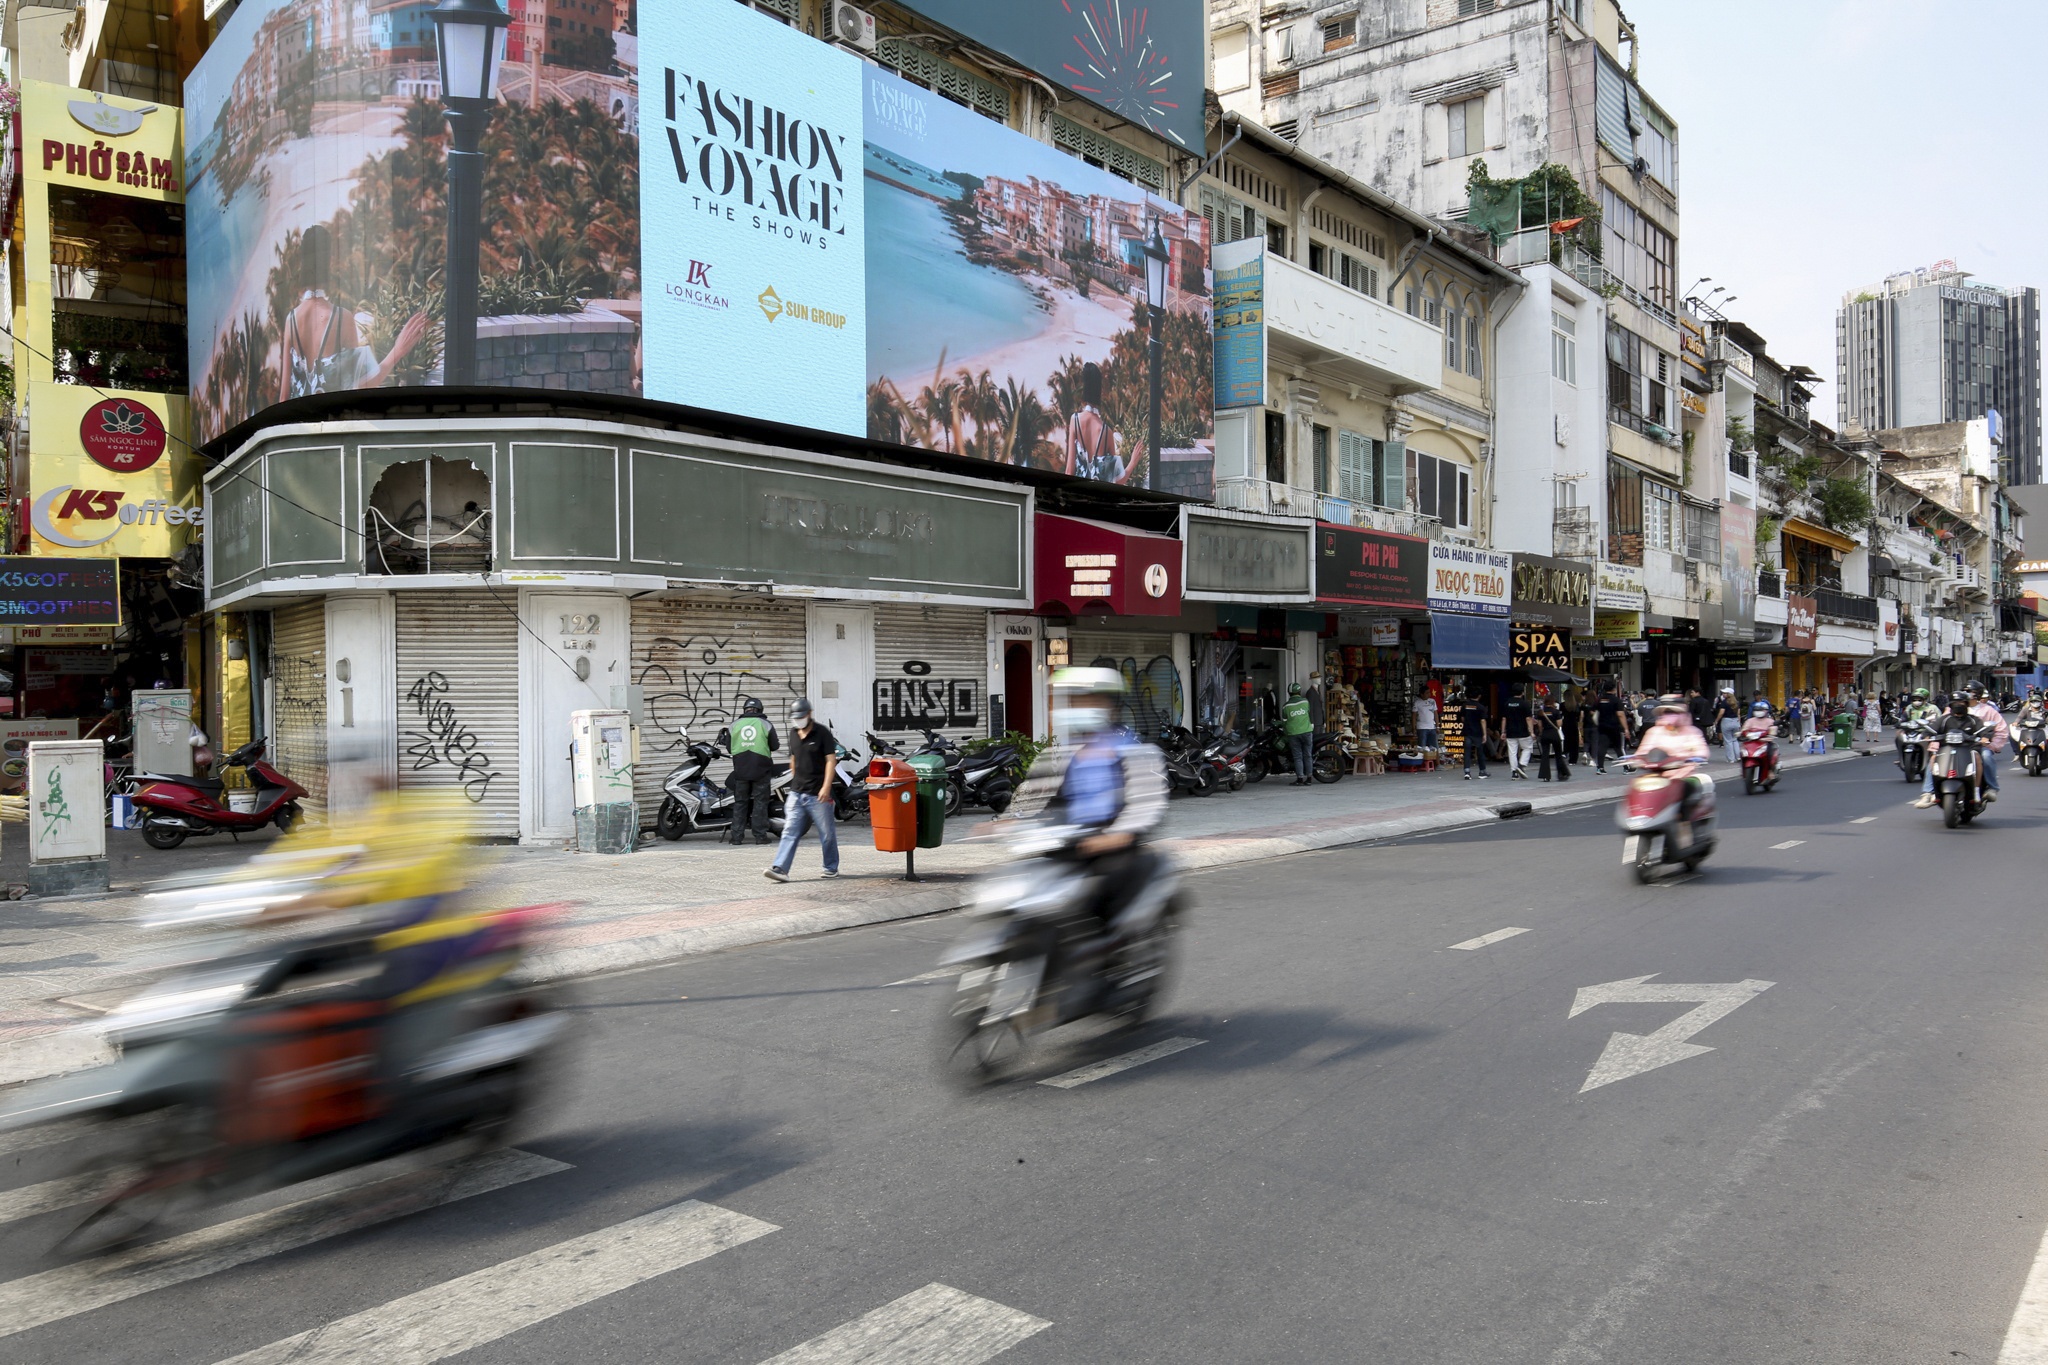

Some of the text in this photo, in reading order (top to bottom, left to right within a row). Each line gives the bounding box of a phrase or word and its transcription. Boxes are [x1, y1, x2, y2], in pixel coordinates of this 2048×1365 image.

[664, 66, 846, 182] FASHION
[42, 139, 113, 181] PHỞ
[116, 151, 173, 178] SÂM
[665, 125, 846, 236] VOYAGE
[692, 196, 828, 249] THE SHOWS
[666, 283, 729, 309] LONGKAN
[785, 301, 847, 330] SUN GROUP
[90, 434, 157, 447] SÂM NGỌC LINH
[113, 453, 135, 463] K5
[1432, 543, 1508, 571] CỬA HÀNG MỸ NGHỆ
[1349, 570, 1409, 583] BESPOKE TAILORING
[1435, 568, 1504, 598] NGỌC THẢO
[560, 614, 600, 635] 122
[1515, 633, 1565, 653] SPA
[1290, 708, 1306, 717] Grab
[1441, 722, 1463, 730] AMPOO
